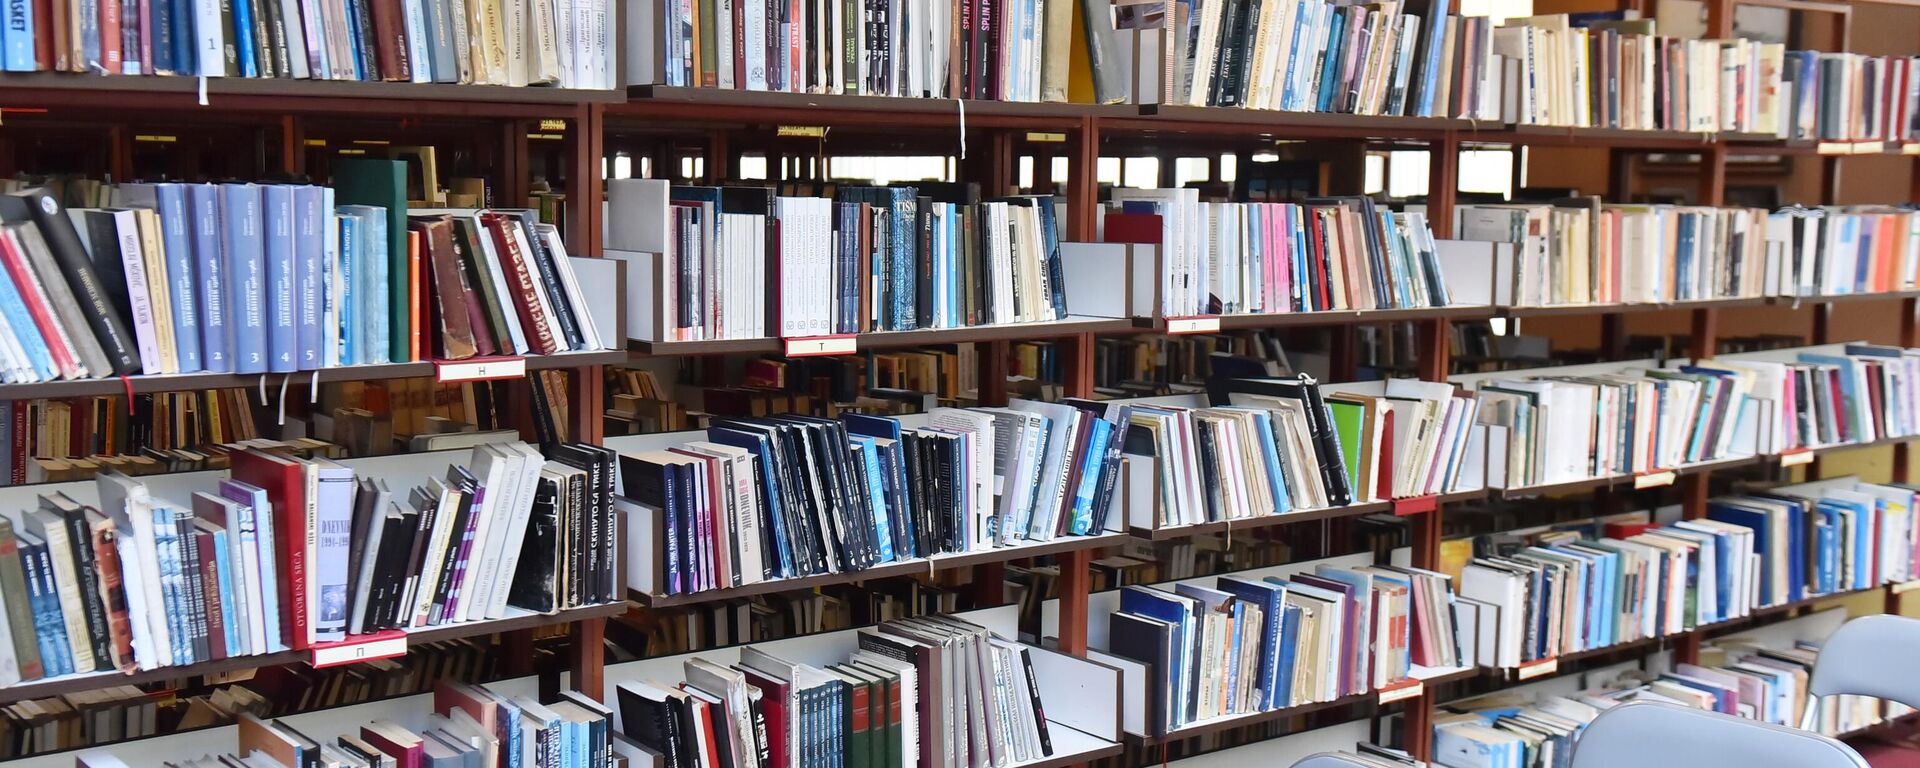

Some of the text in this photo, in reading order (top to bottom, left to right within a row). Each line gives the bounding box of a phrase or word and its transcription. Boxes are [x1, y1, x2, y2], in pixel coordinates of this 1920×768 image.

[962, 5, 970, 29] SPLIN
[981, 6, 990, 31] SPLIN
[208, 38, 216, 50] 1
[189, 352, 195, 360] 1
[213, 352, 223, 360] 2
[250, 352, 260, 363] 3
[281, 352, 289, 362] 4
[306, 351, 314, 361] 5
[1032, 465, 1040, 487] СТАРО
[591, 492, 598, 504] СА
[607, 491, 614, 503] СА
[739, 493, 752, 530] DNEVNIK
[590, 505, 598, 547] СКИНУТО
[292, 551, 305, 626] OTVORENA SRCA
